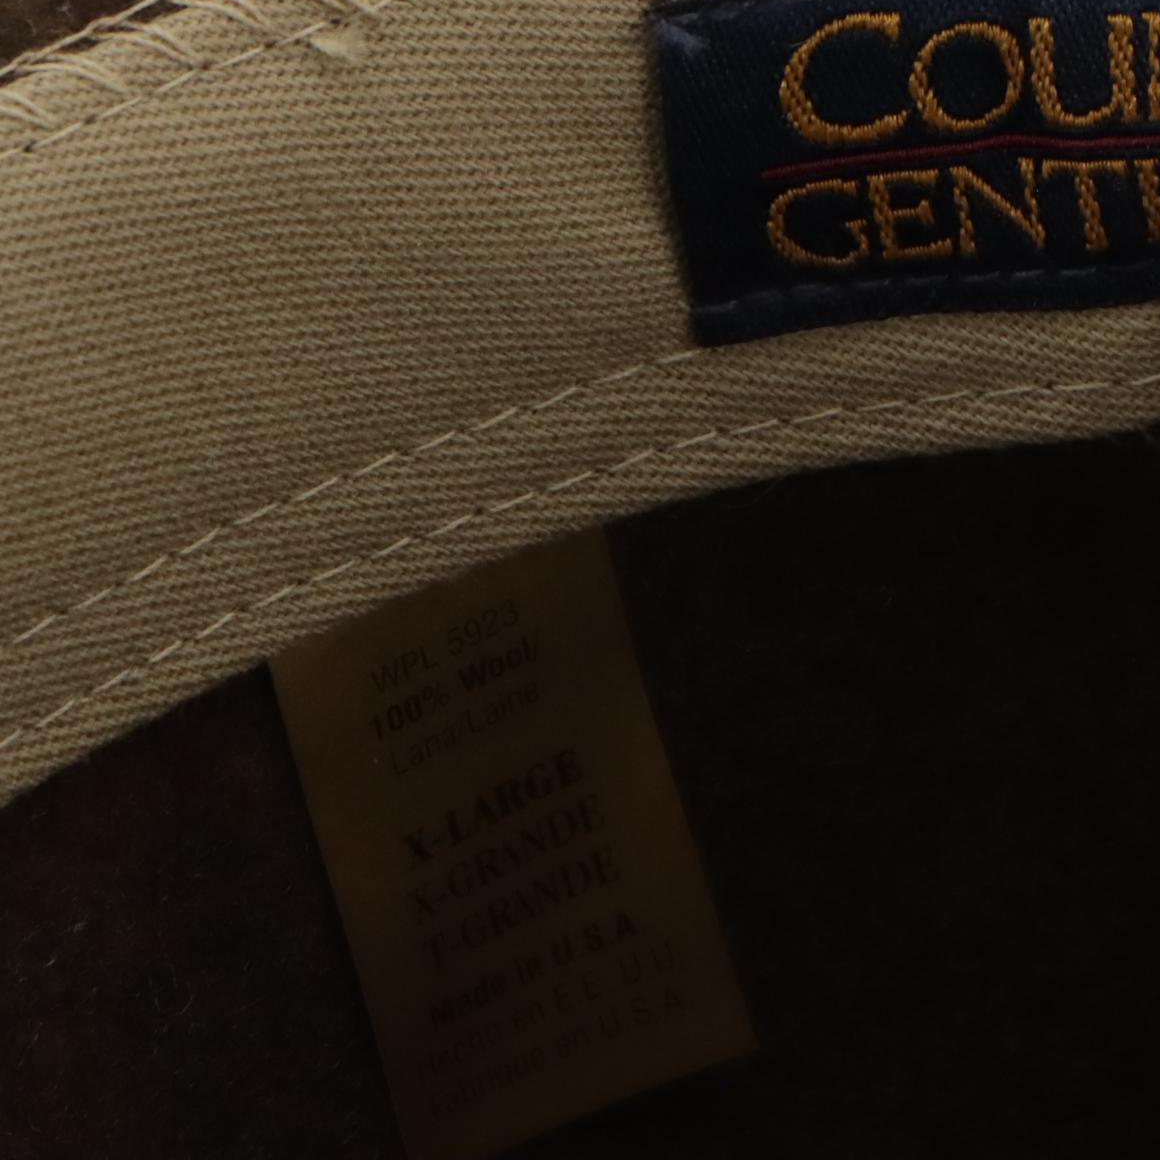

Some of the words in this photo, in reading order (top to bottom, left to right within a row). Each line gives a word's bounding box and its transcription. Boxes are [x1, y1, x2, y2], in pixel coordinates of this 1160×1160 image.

[370, 647, 439, 695] WPL
[446, 598, 520, 656] 5923
[368, 683, 451, 740] 100%
[399, 747, 584, 870] X-LARGE
[428, 973, 508, 1032] Made
[514, 956, 544, 986] in
